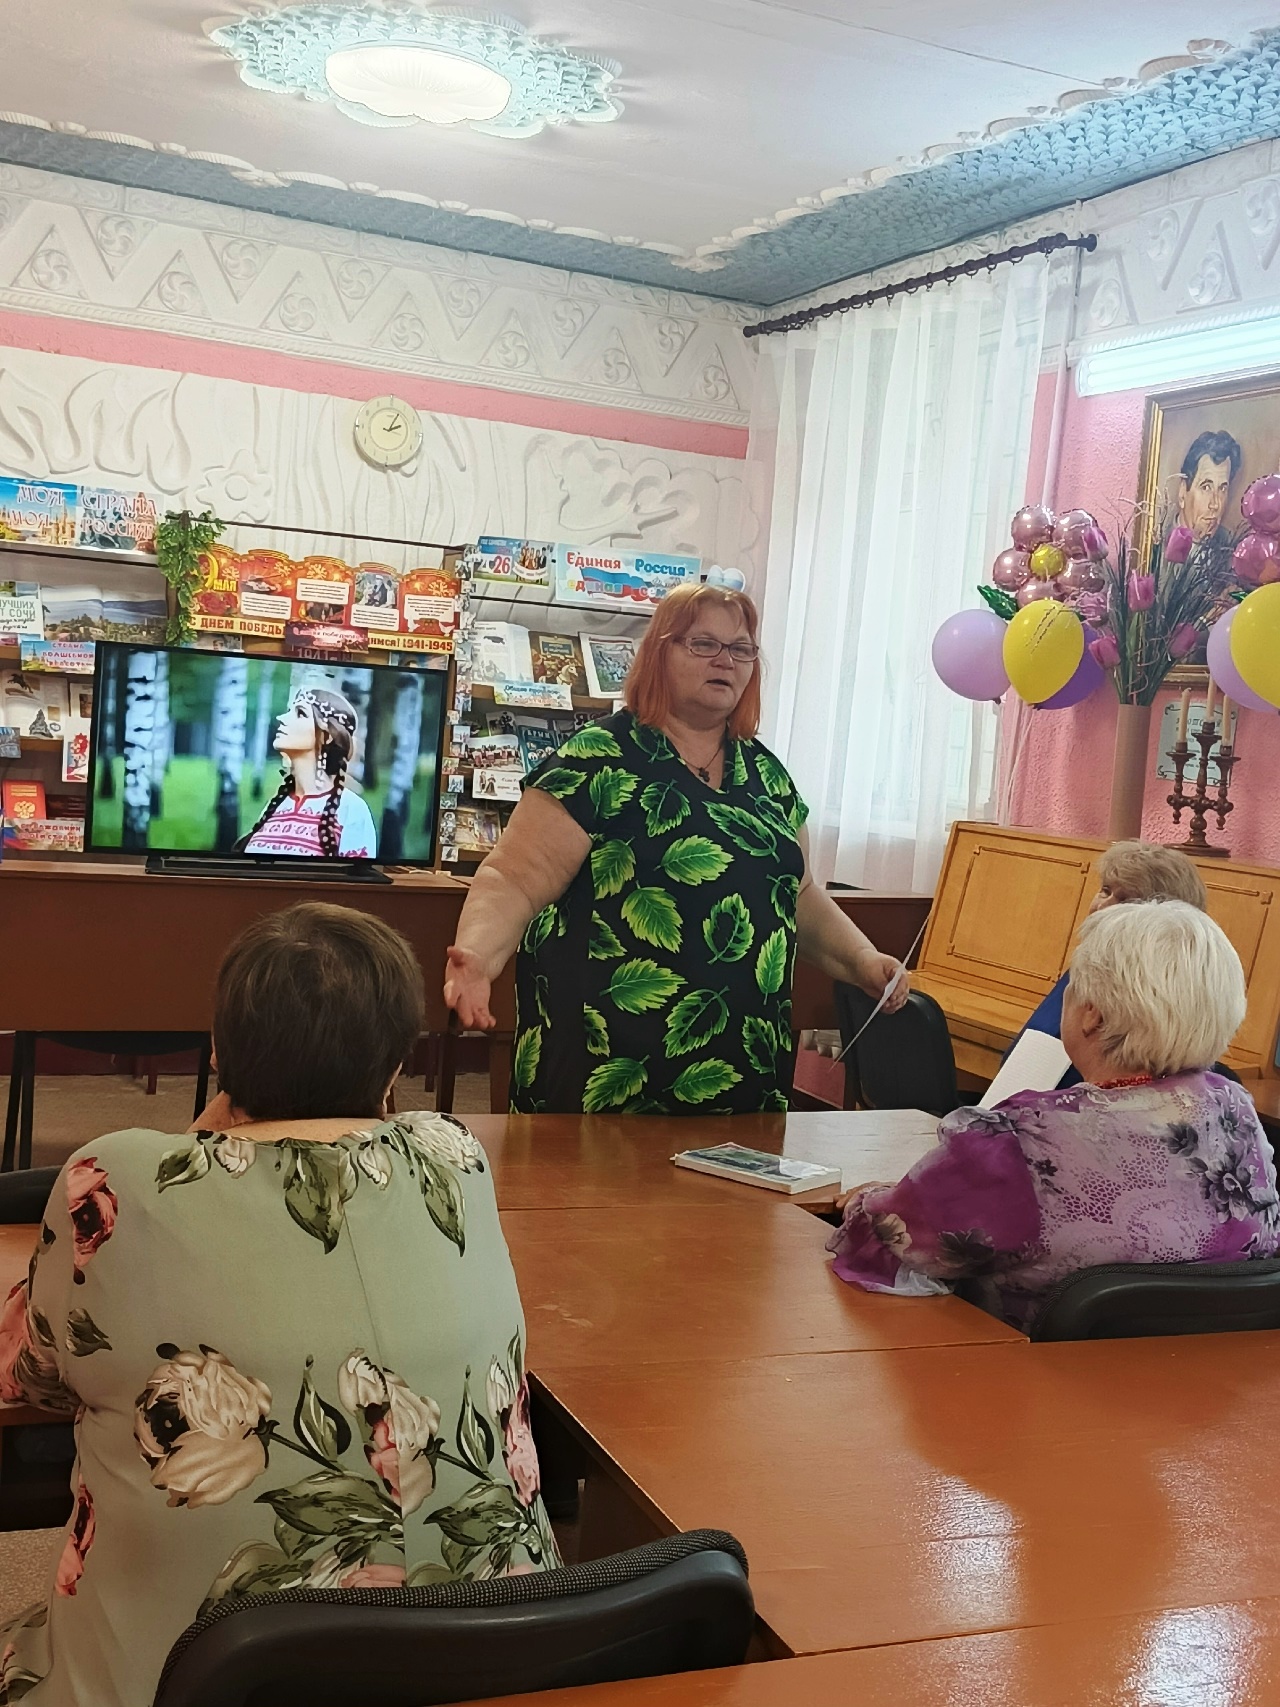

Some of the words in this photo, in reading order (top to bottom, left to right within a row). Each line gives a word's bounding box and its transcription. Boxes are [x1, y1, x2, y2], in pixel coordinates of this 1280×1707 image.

[17, 485, 63, 506] МОЯ
[8, 510, 49, 529] МОЯ
[566, 552, 621, 569] Единая
[635, 558, 686, 577] Россия
[213, 579, 238, 592] МАЯ
[567, 579, 622, 593] единая
[640, 586, 667, 598] сем
[0, 600, 35, 610] УЧШИХ
[9, 608, 36, 619] СОЧИ
[201, 618, 234, 630] ДНЕМ
[403, 638, 453, 652] 1941-1945
